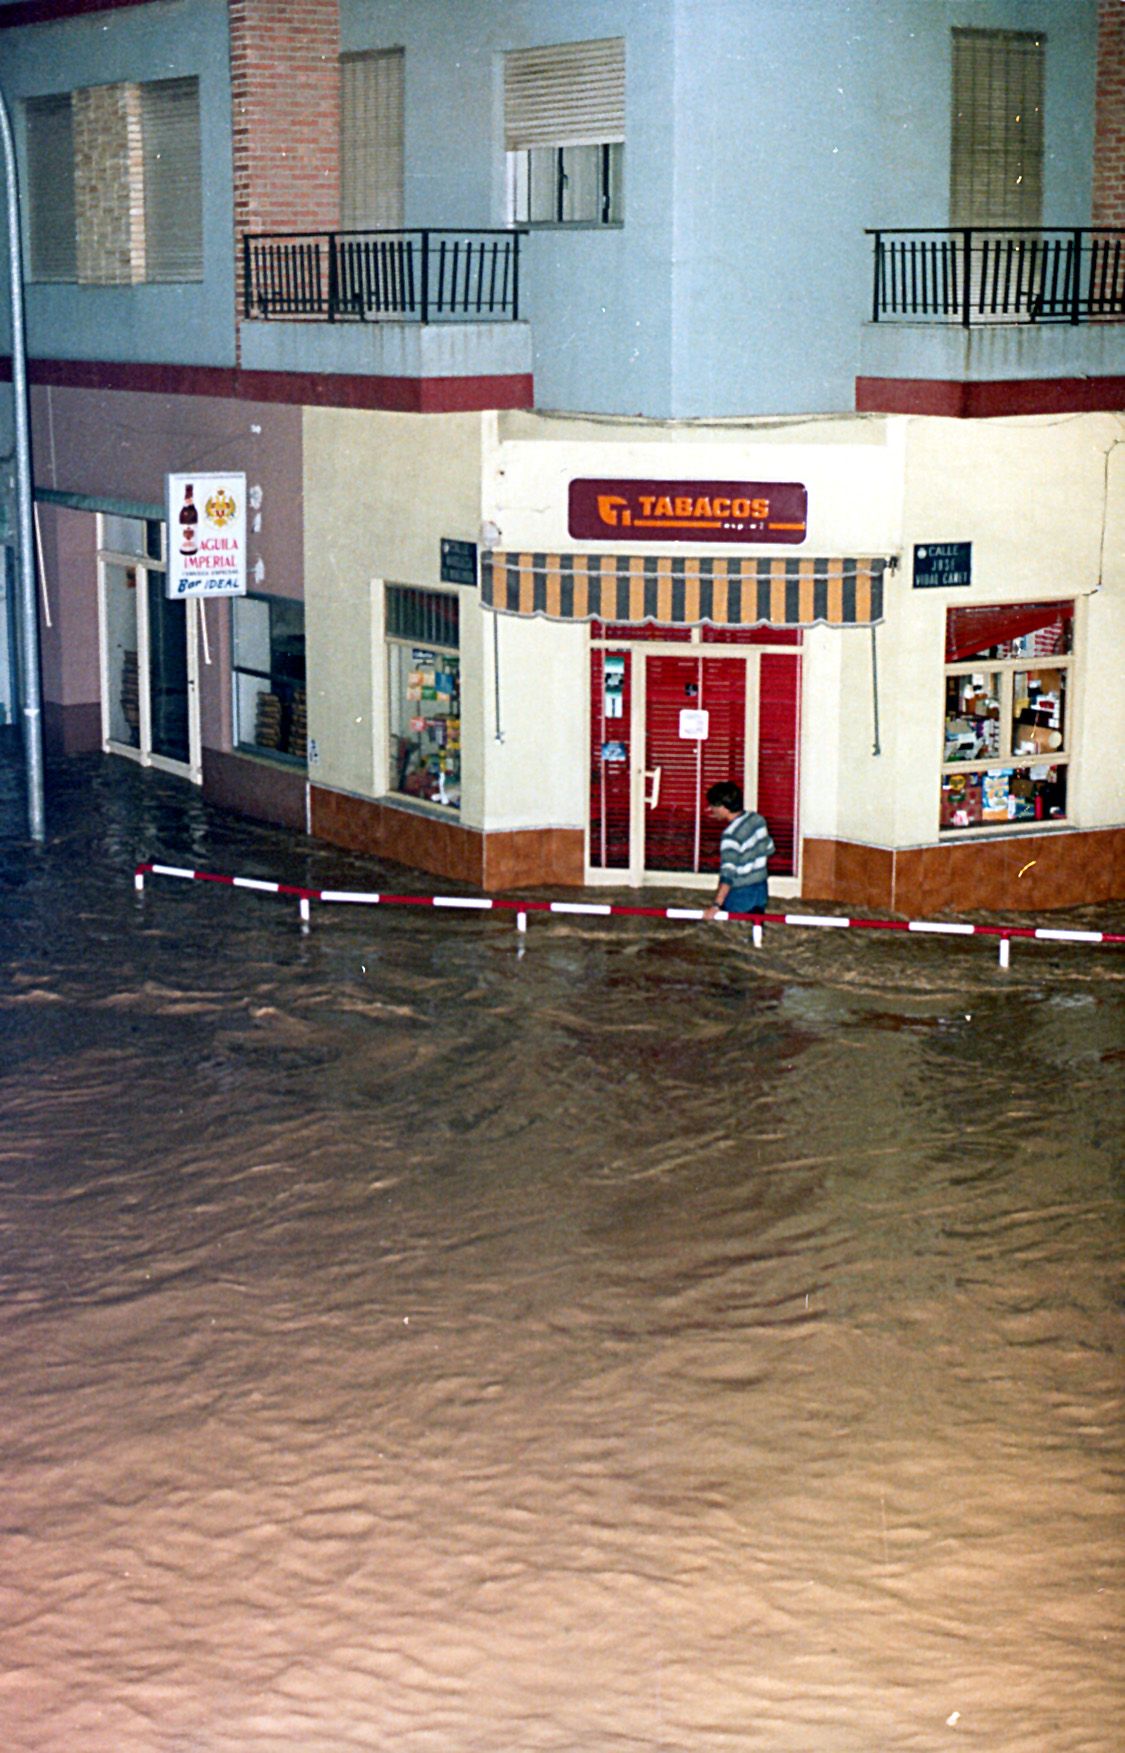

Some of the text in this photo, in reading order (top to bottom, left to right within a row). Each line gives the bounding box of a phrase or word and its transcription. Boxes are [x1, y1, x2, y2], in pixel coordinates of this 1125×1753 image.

[639, 496, 769, 519] TABACOS
[200, 538, 239, 551] AGUILA
[928, 545, 958, 556] CALLE
[184, 555, 236, 568] IMPERIAL
[178, 578, 239, 593] Bar IDEAL
